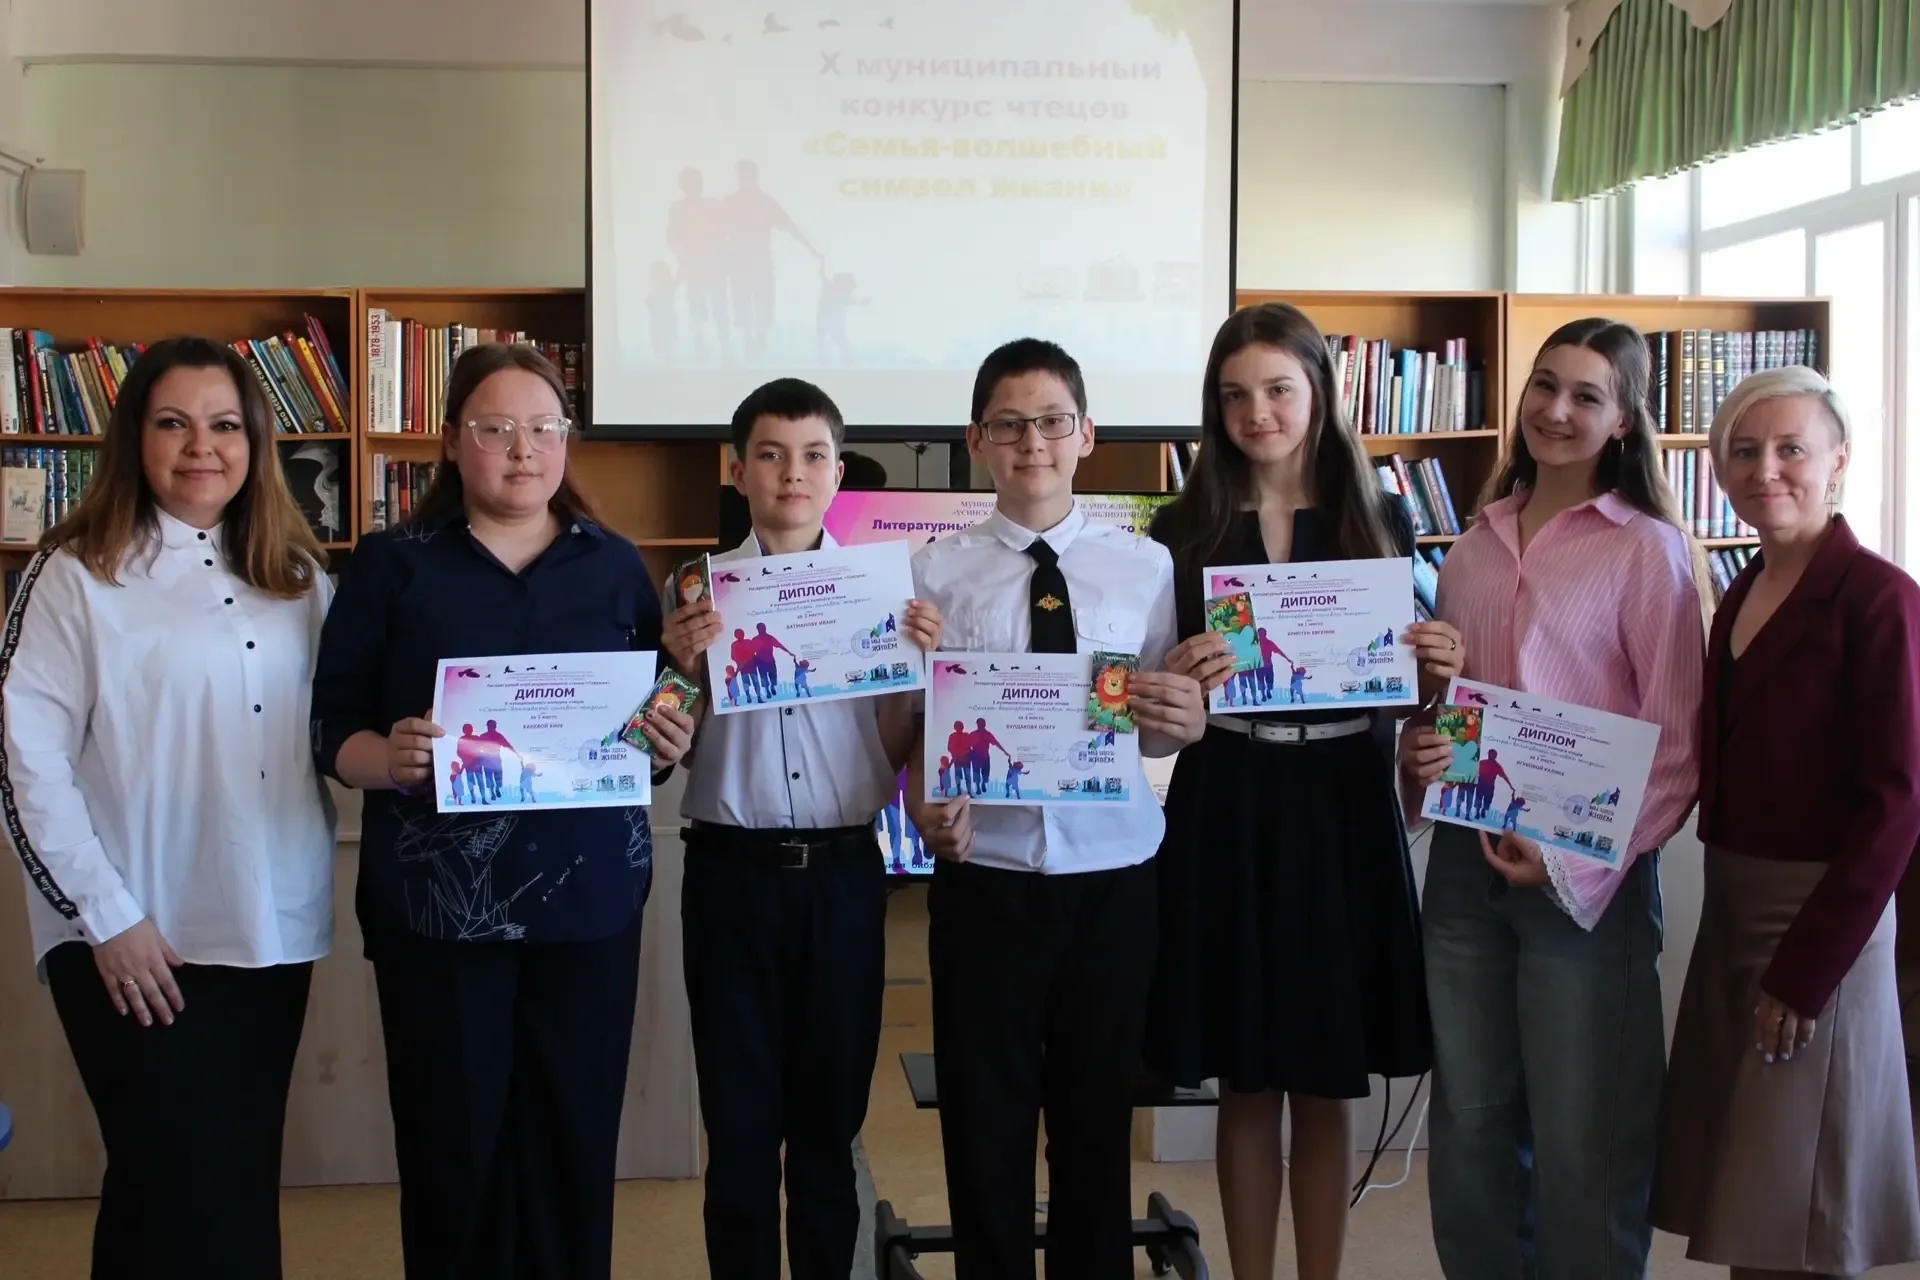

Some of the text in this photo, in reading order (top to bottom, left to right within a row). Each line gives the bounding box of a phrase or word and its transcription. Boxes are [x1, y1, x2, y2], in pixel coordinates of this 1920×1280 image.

[856, 53, 1162, 83] муниципальный
[840, 97, 1129, 123] конкурс чтецов
[838, 177, 976, 199] символ
[371, 313, 381, 358] 1878-1953
[872, 519, 975, 533] Литературны
[777, 583, 835, 601] ДИПЛОМ
[1280, 594, 1336, 608] ДИПЛОМ
[514, 687, 575, 700] ДИПЛОМ
[1001, 688, 1059, 700] ДИПЛОМ
[1518, 726, 1576, 748] ДИПЛОМ
